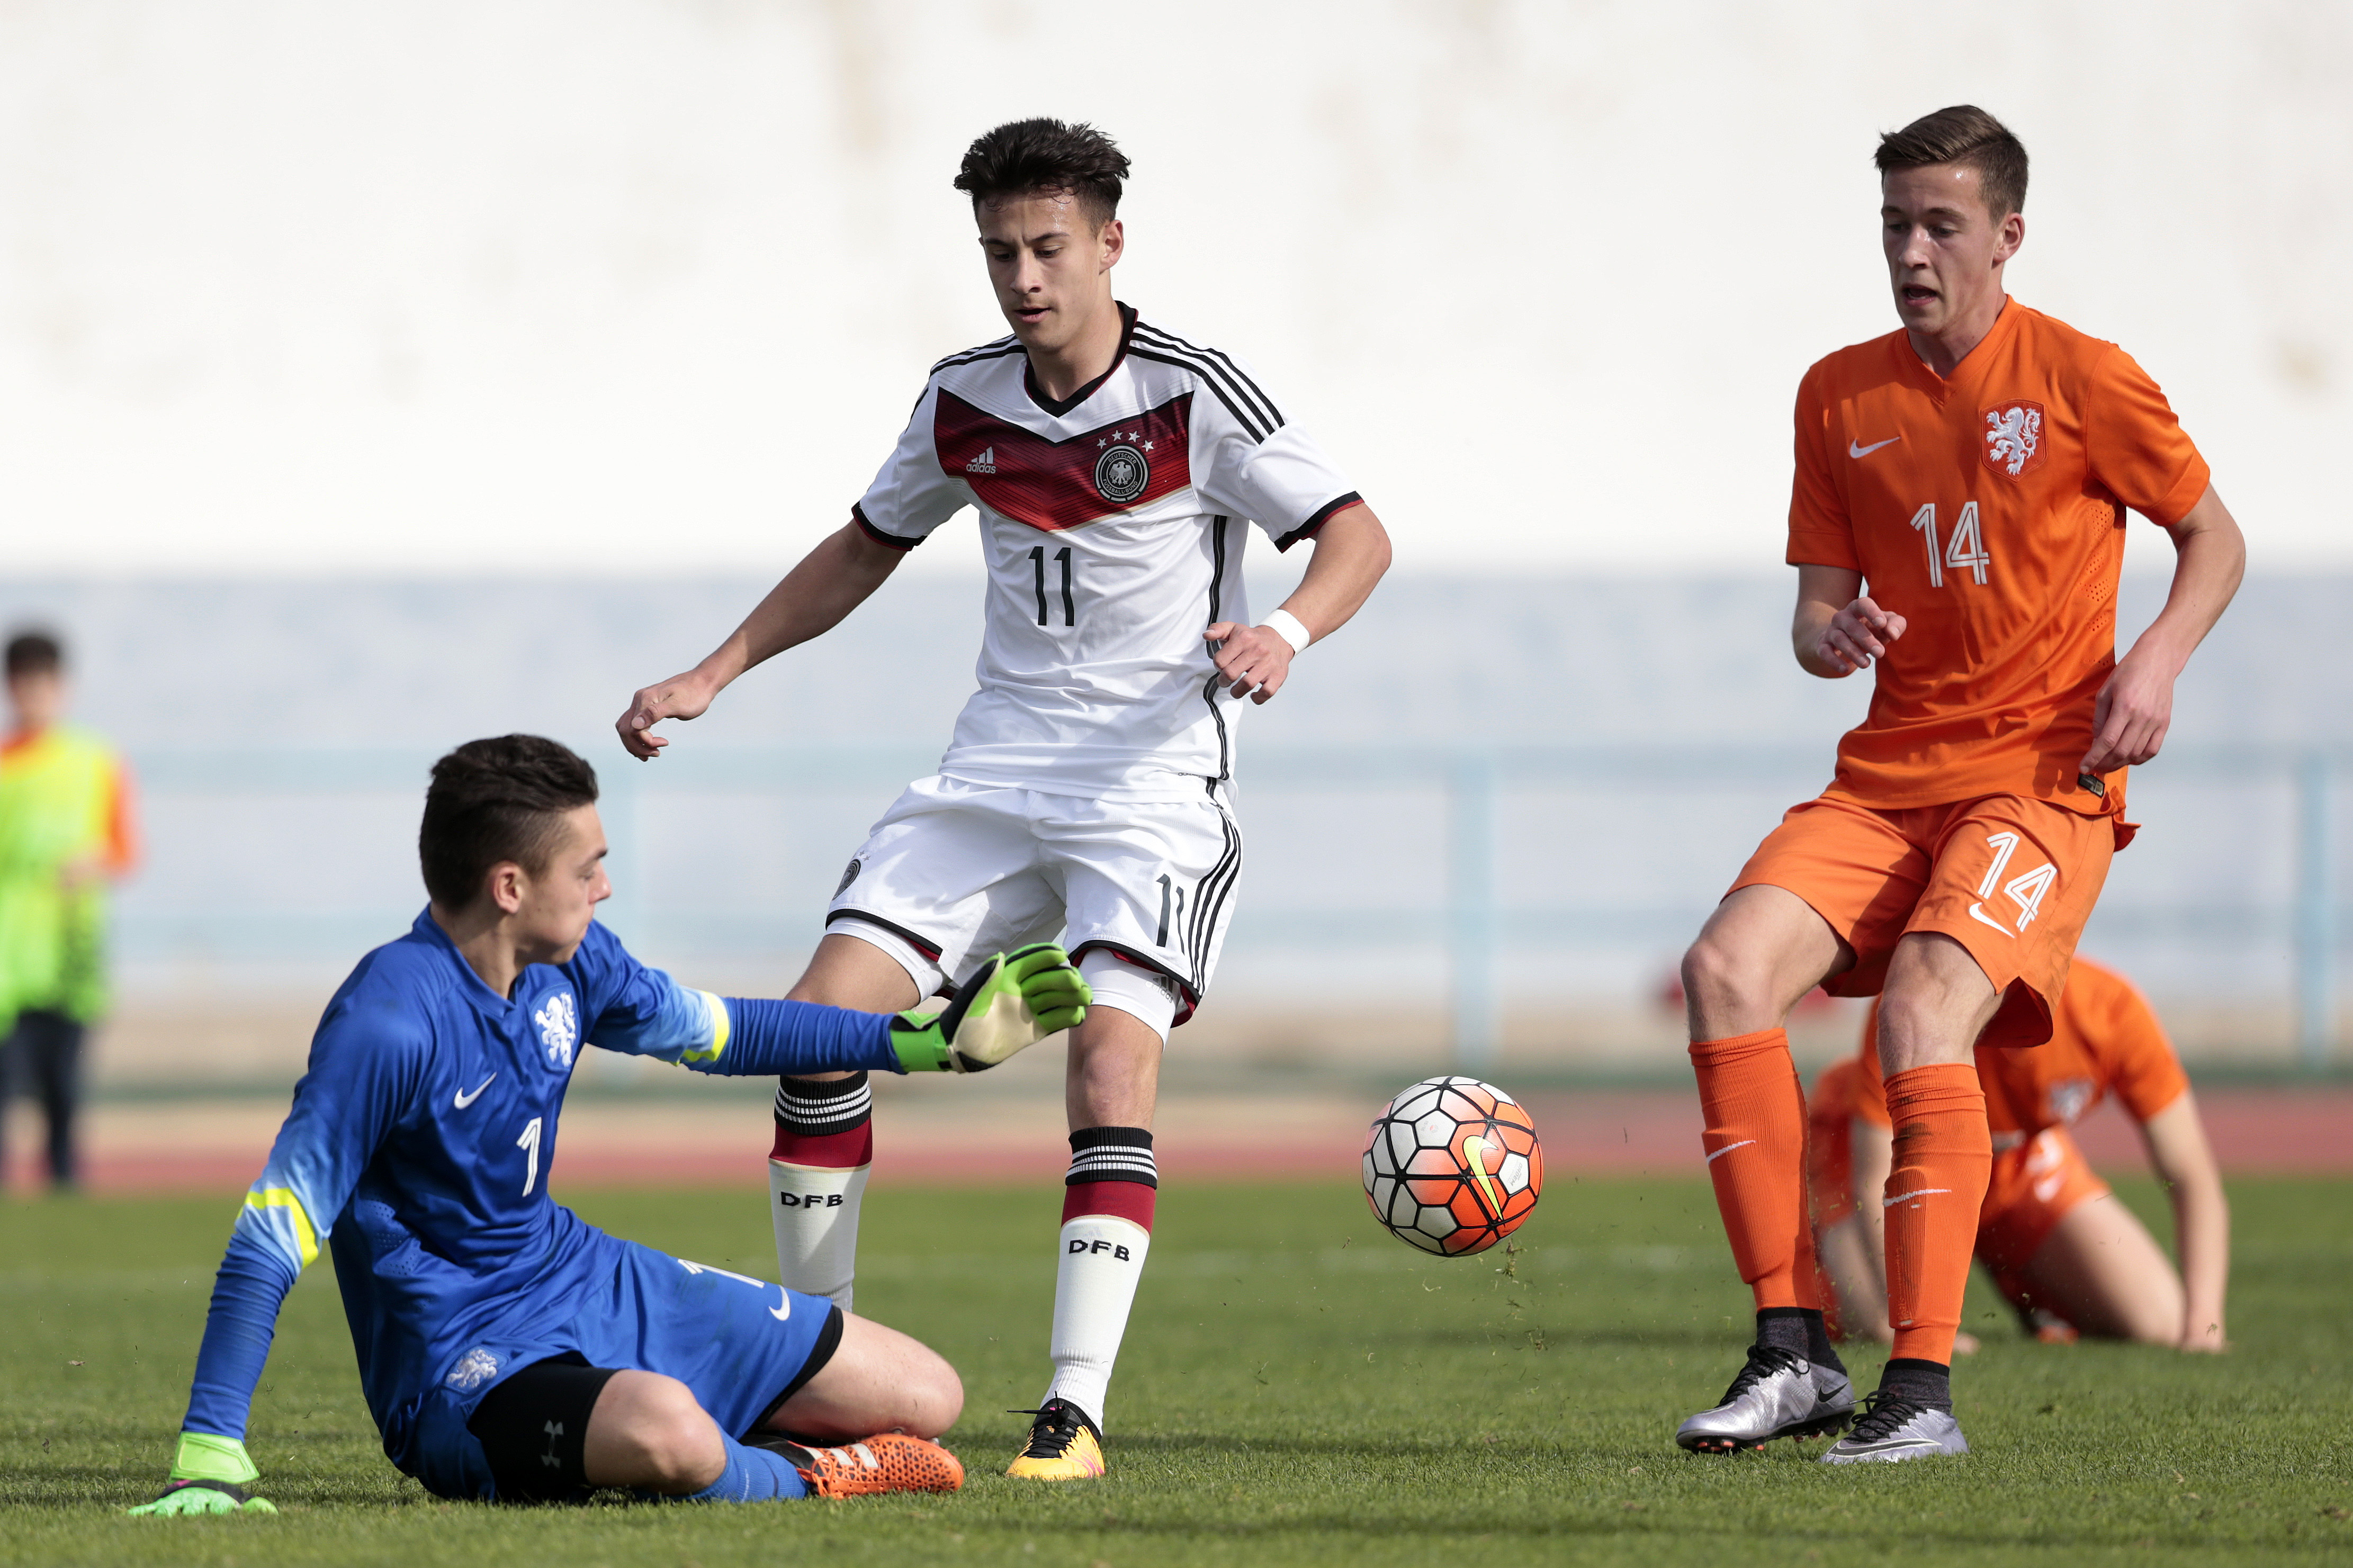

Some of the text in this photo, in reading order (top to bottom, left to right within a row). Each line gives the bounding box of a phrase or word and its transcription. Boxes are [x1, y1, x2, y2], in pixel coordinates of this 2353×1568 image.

[966, 462, 996, 474] adidas
[1108, 453, 1137, 464] DEUTSCHER
[1910, 501, 1990, 588] 14
[1028, 546, 1074, 626] 11
[1156, 873, 1185, 956] 11
[1978, 832, 2058, 933] 14
[516, 1116, 542, 1197] 1
[781, 1192, 843, 1208] DFB
[1069, 1239, 1129, 1261] DFB
